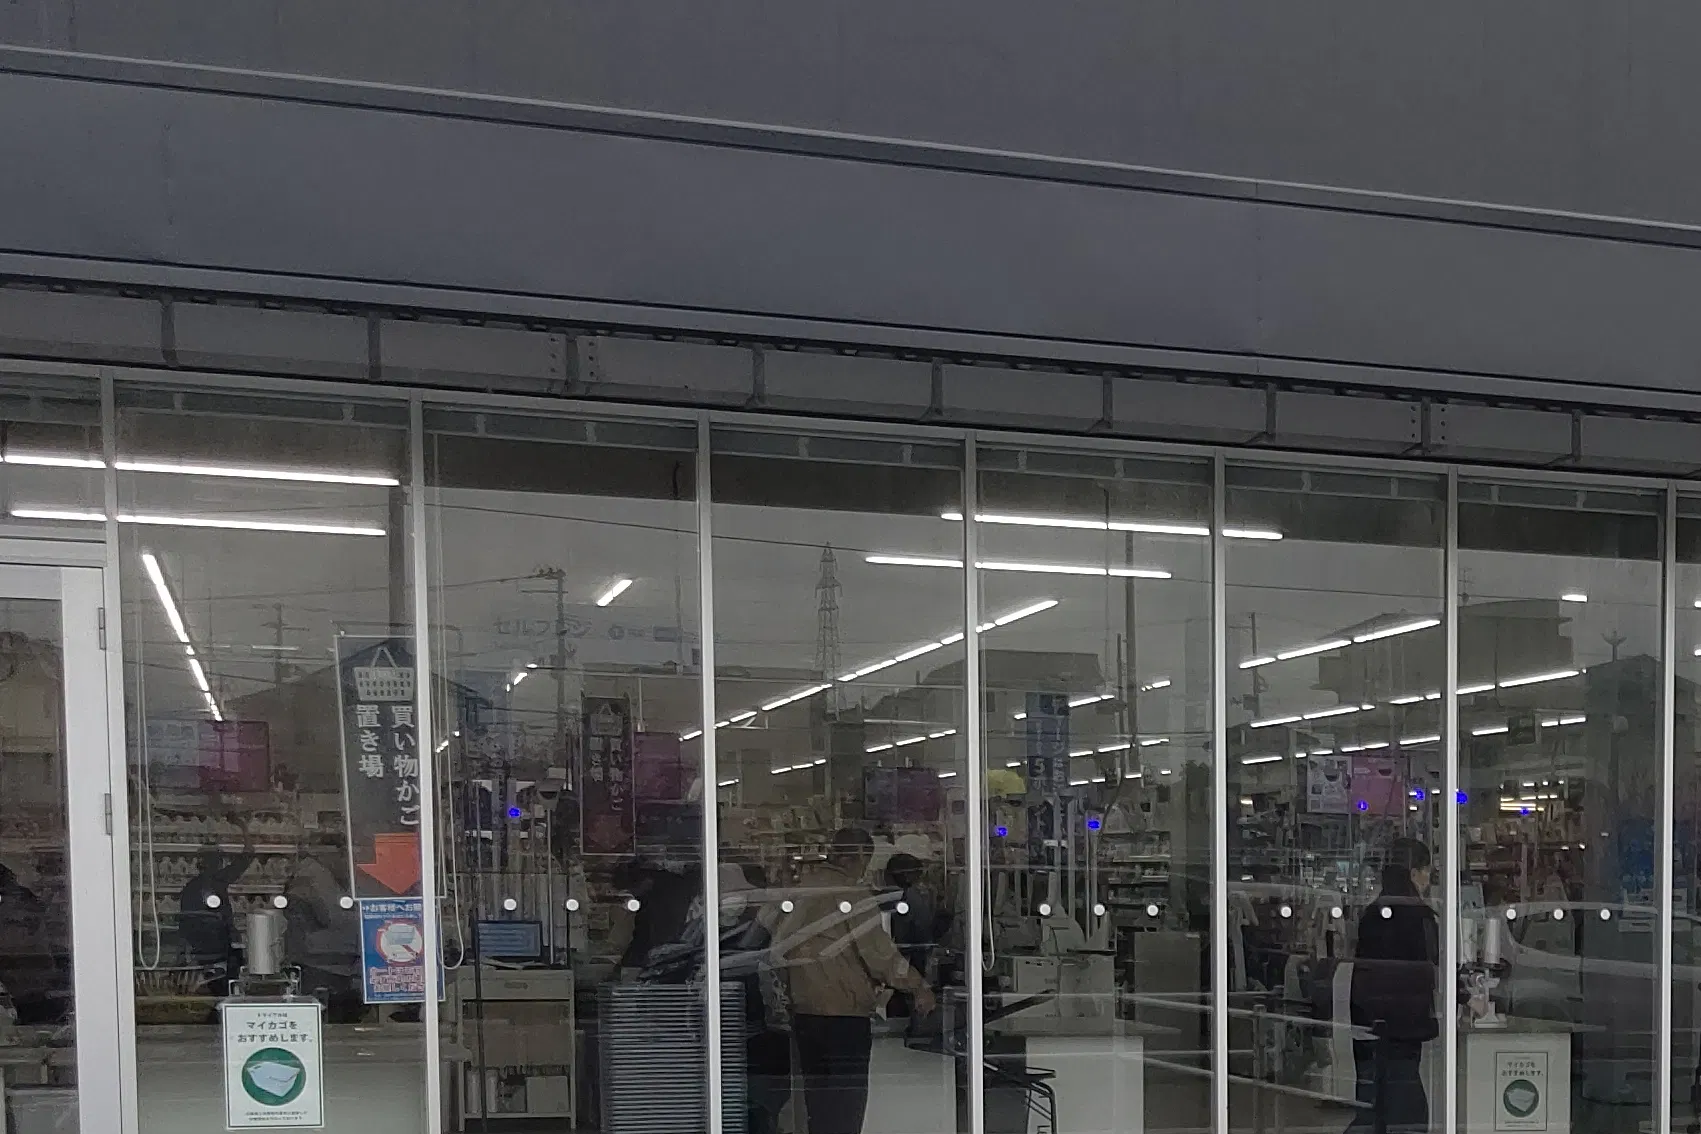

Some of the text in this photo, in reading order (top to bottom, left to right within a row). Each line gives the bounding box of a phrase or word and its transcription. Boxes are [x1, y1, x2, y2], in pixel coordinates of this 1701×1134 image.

[356, 704, 384, 778] 置き場
[391, 705, 420, 826] 買い物かご
[237, 1033, 313, 1043] おすすめします。
[246, 1021, 298, 1030] マイカゴを
